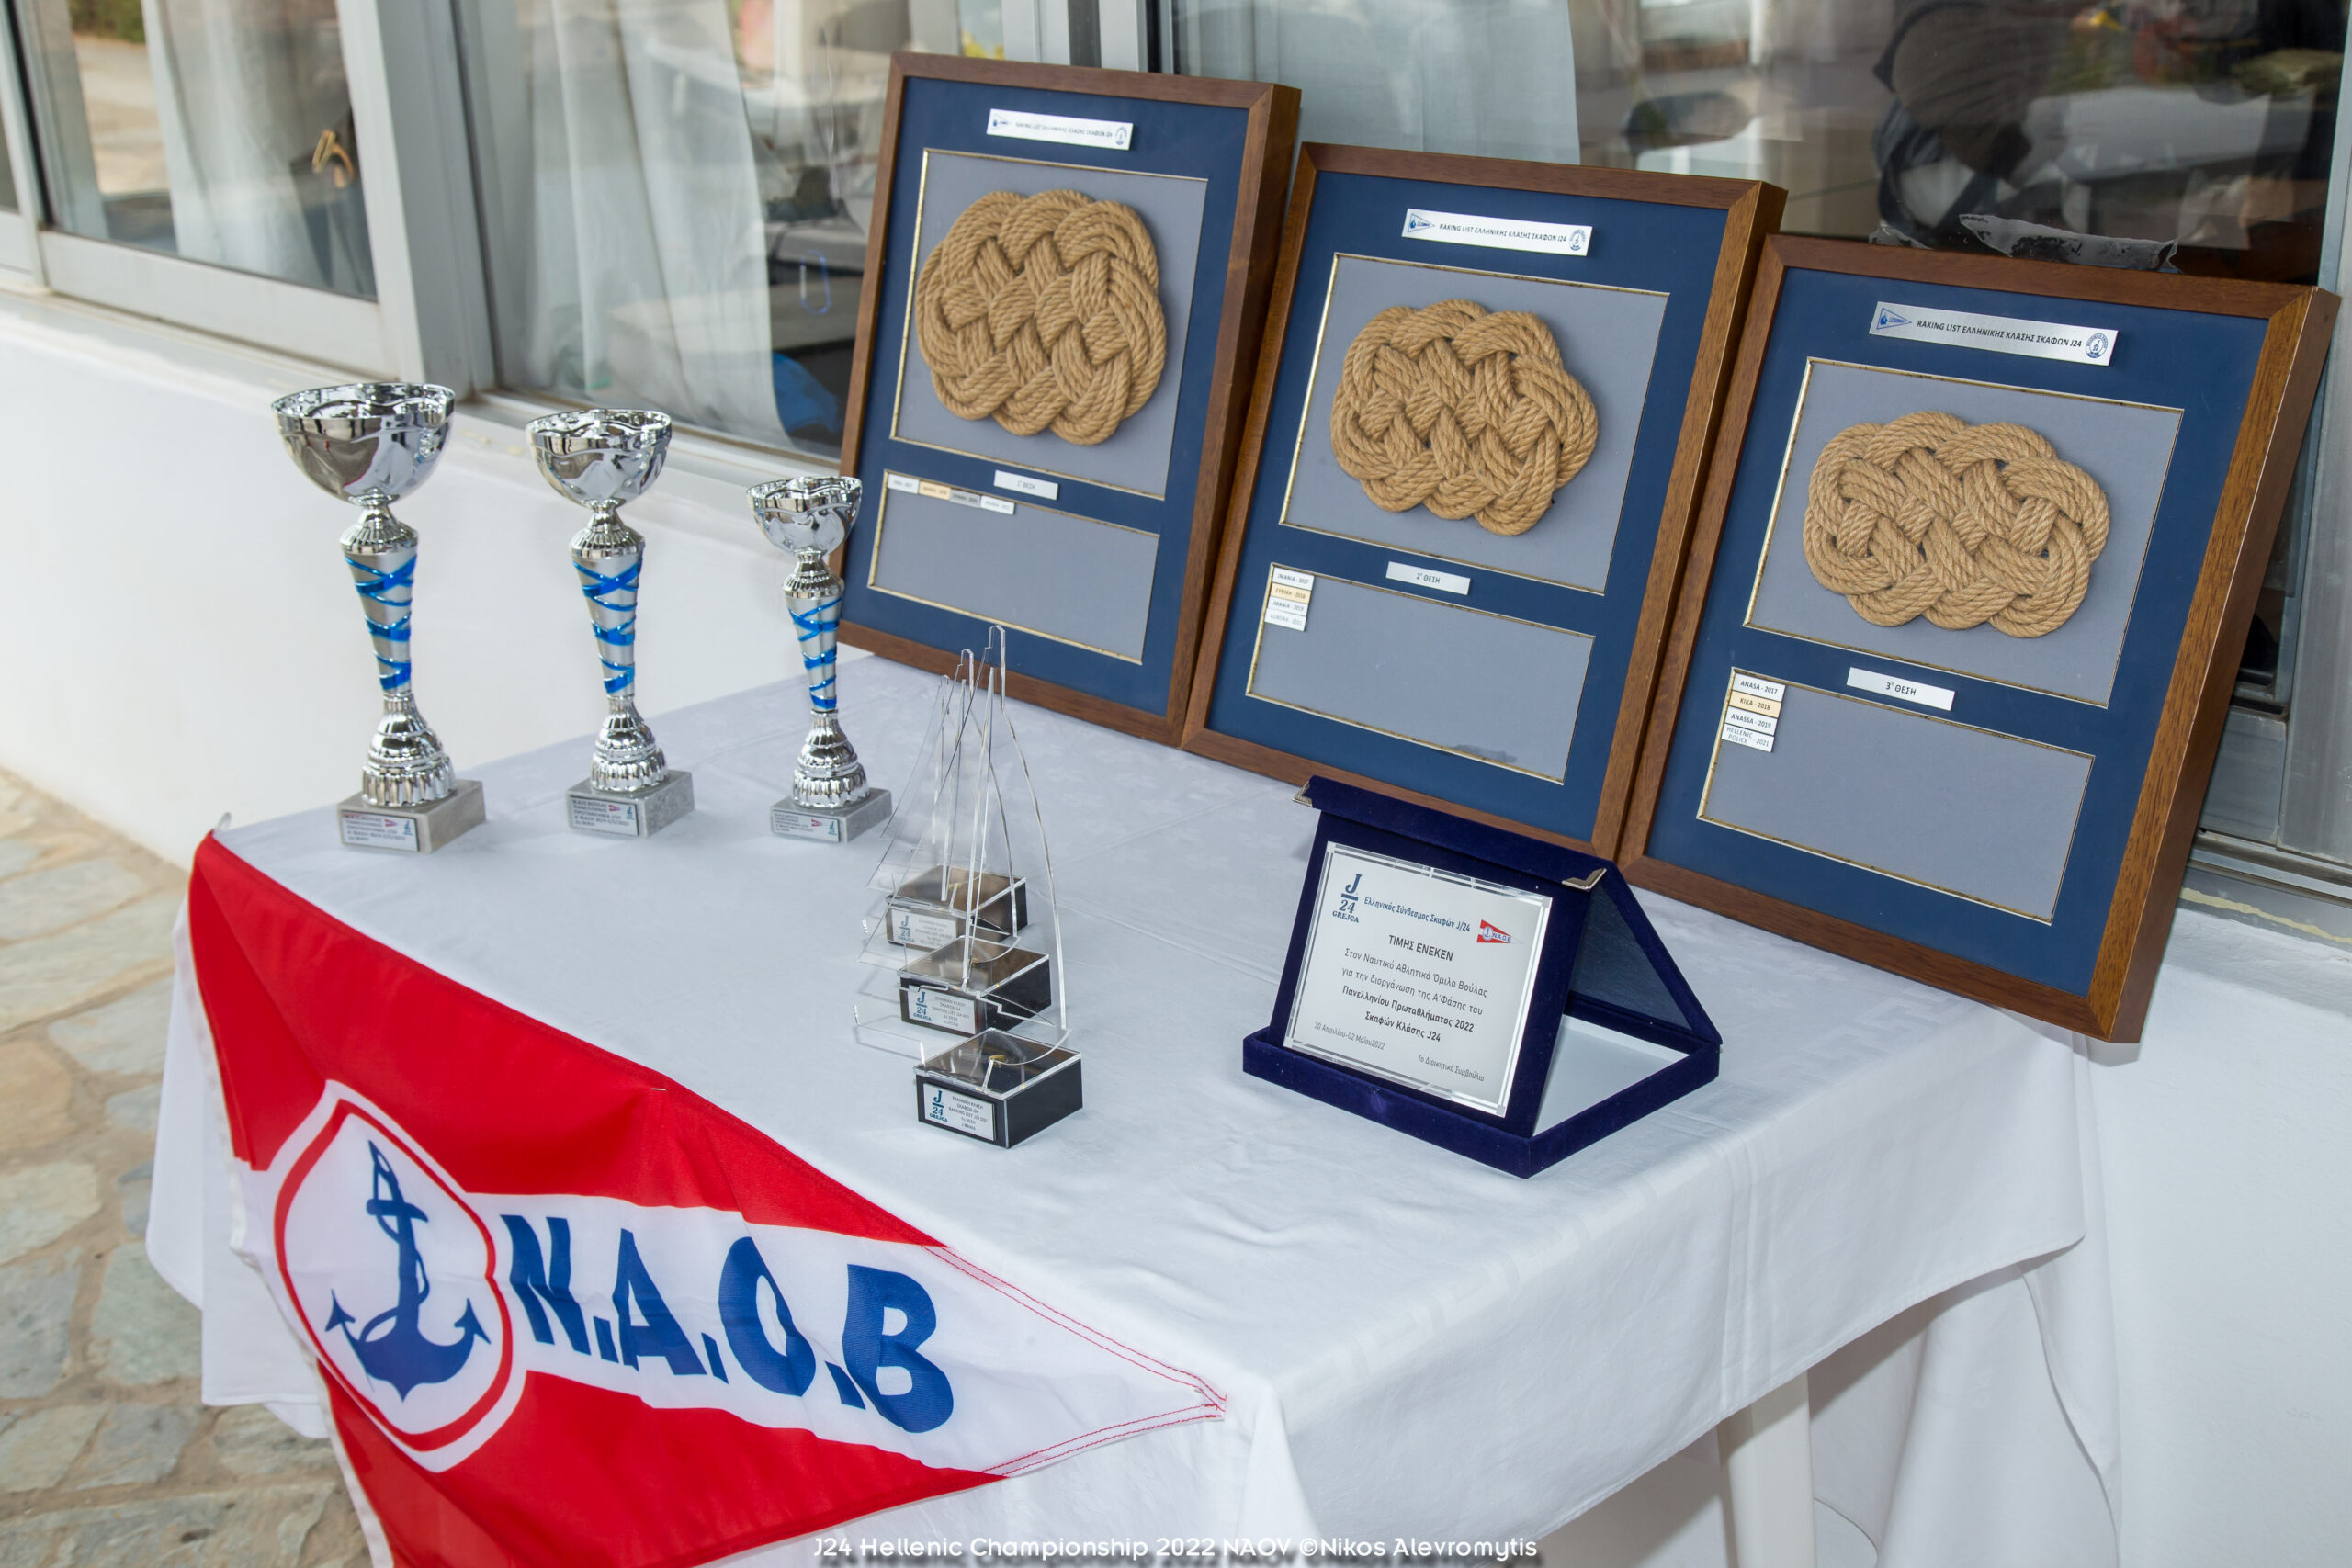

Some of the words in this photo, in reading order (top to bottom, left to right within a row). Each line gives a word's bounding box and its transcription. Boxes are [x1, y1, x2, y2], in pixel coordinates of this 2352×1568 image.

[1439, 223, 1462, 232] RAKING
[1917, 320, 1945, 332] RAKING
[1946, 323, 1962, 333] LIST
[1962, 325, 2006, 339] ΕΛΛΗΝΙΚΗΣ
[2005, 331, 2036, 342] ΚΛΑΣΗΣ
[2036, 334, 2069, 347] ΣΚΑΦΩΝ
[2069, 337, 2083, 348] J24
[1740, 680, 1760, 690] ANASA
[1764, 686, 1778, 694] 2017
[1894, 684, 1917, 695] ΘΕΣΗ
[1739, 697, 1753, 706] KIKA
[1757, 702, 1771, 710] 2018
[1731, 714, 1754, 724] ANASSA
[1758, 720, 1771, 728] 2019
[1726, 727, 1753, 739] HELLENIC
[1728, 734, 1747, 743] POLICE
[1756, 739, 1770, 747] 2021
[1345, 873, 1363, 894] J
[1339, 899, 1356, 914] 24
[1332, 910, 1360, 923] GREJCA
[1363, 896, 1396, 912] Ελληνικός
[1396, 904, 1430, 921] Σύνδεσμος
[1430, 913, 1455, 929] Σκαφών
[1456, 921, 1471, 932] J/24
[1388, 934, 1415, 951] ΤΙΜΗΣ
[1415, 942, 1453, 962] ΕΝΕΚΕΝ
[1344, 947, 1362, 960] Στον
[1363, 952, 1395, 970] Ναυτικό
[1396, 964, 1431, 981] Αθλητικό
[1458, 980, 1488, 998] Βούλας
[1341, 967, 1353, 977] για
[1355, 971, 1370, 982] την
[1370, 974, 1416, 997] διοργάνωση
[1417, 988, 1431, 1001] της
[1469, 1004, 1484, 1016] του
[1342, 986, 1390, 1007] Πανελληνίου
[1391, 999, 1453, 1027] Πρωταθλήματος
[1454, 1018, 1475, 1032] 2022
[1364, 1010, 1395, 1028] Σκαφών
[1396, 1021, 1426, 1038] Κλάσης
[1426, 1030, 1442, 1043] J24
[933, 1089, 943, 1103] J
[933, 1106, 944, 1116] 24
